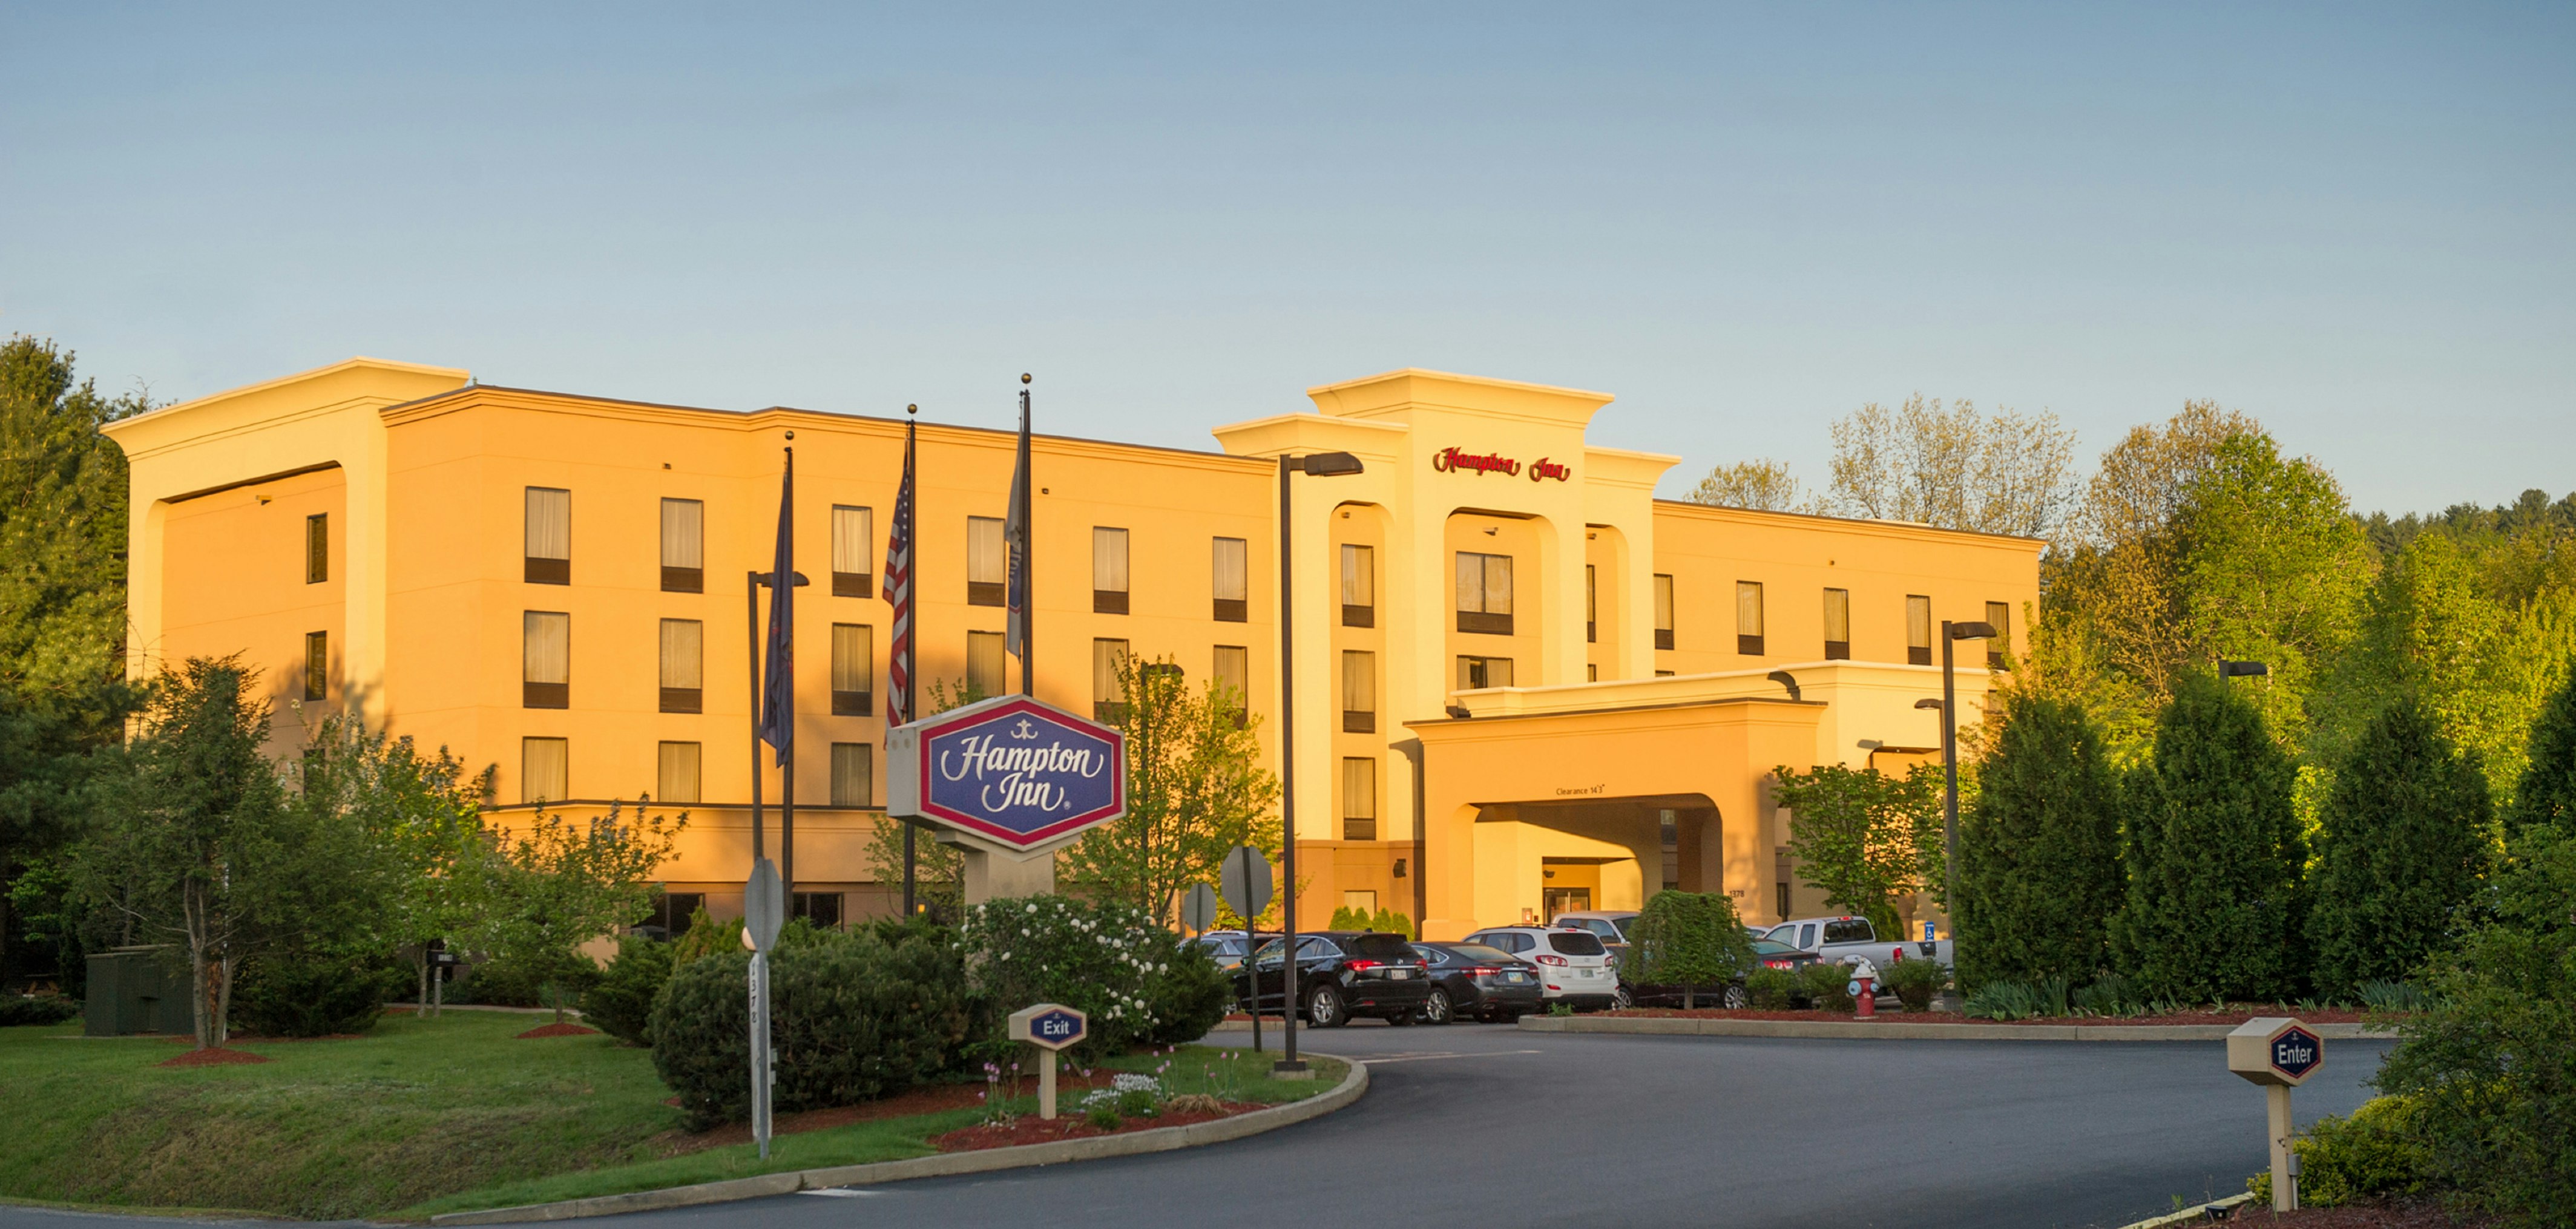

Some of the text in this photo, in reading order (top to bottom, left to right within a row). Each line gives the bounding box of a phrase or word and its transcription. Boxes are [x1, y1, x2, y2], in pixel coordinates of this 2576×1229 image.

[1433, 447, 1571, 482] Hampton Inn
[941, 734, 1104, 781] Hampton
[1043, 1020, 1070, 1035] Exit
[2278, 1044, 2312, 1064] Enter
